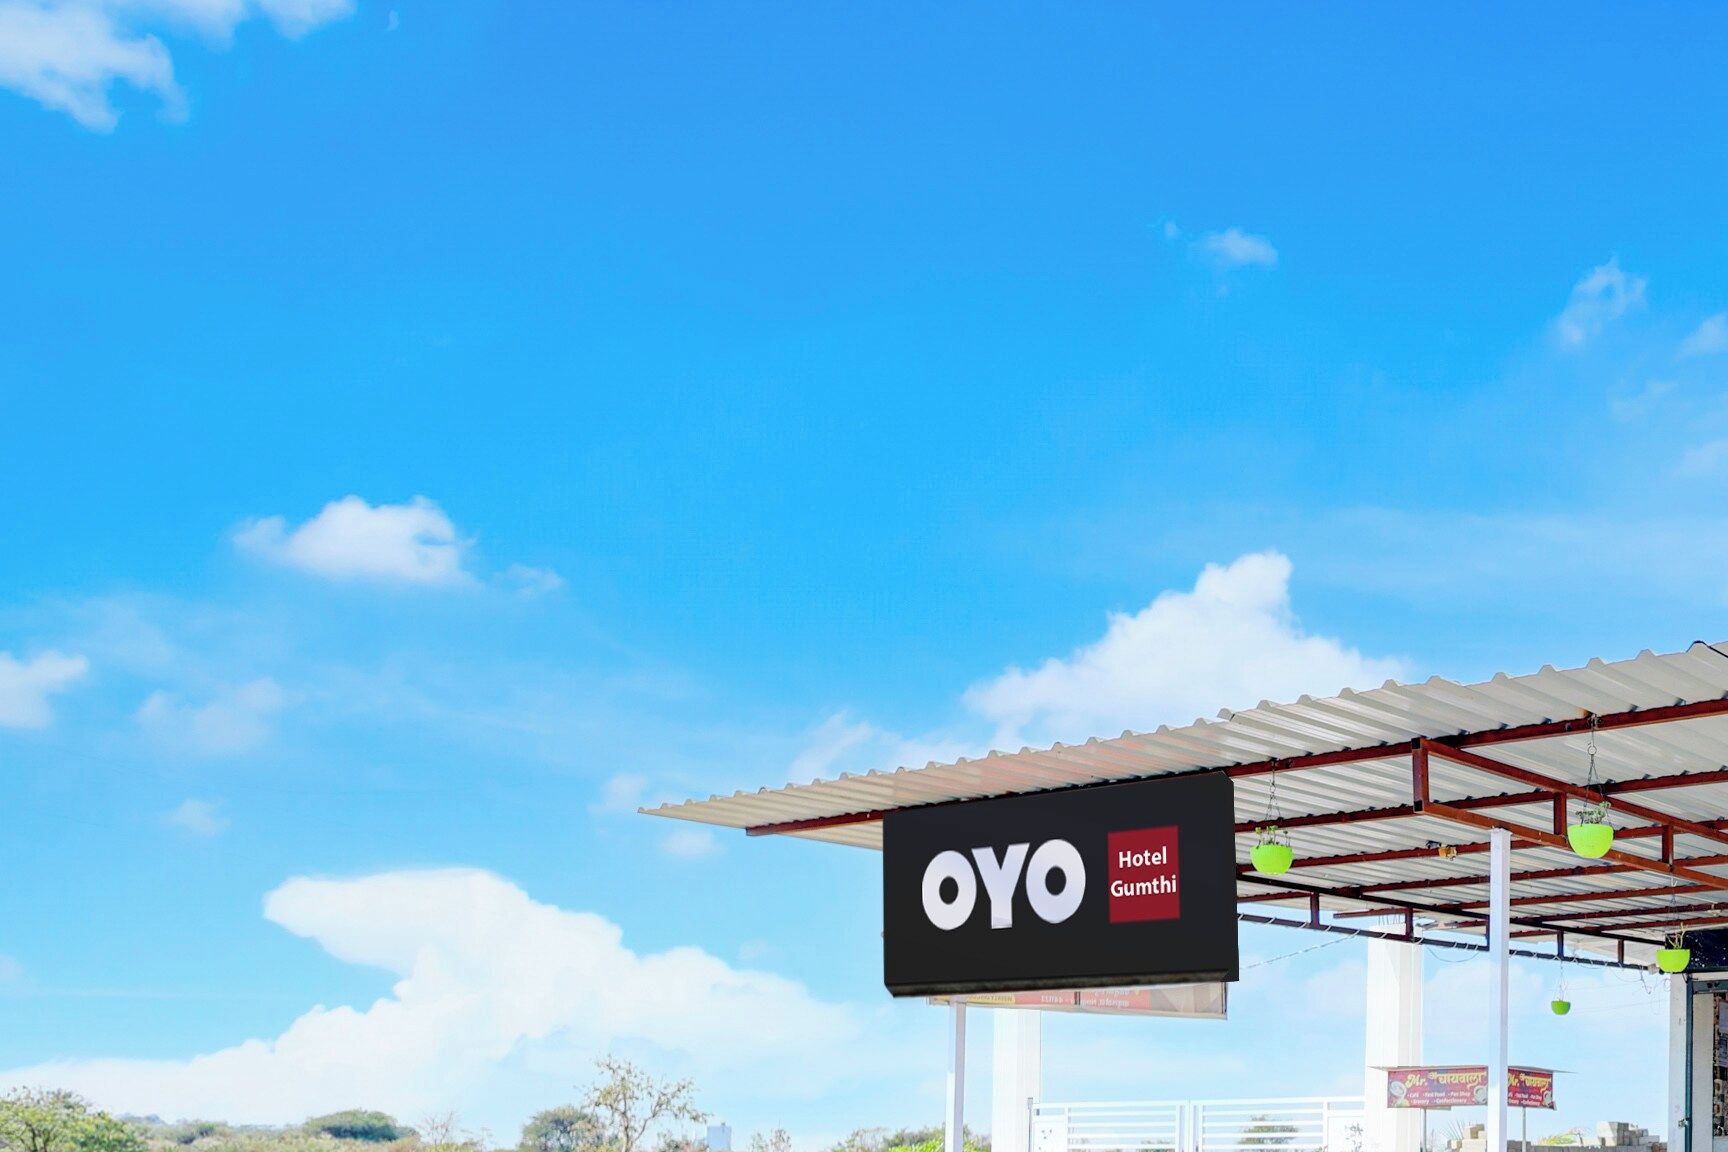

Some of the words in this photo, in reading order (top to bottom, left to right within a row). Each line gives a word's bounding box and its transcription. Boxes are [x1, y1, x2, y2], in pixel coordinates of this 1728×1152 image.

[1118, 846, 1167, 869] Hotel
[922, 839, 1086, 930] OYO
[1110, 874, 1177, 898] Gumthi
